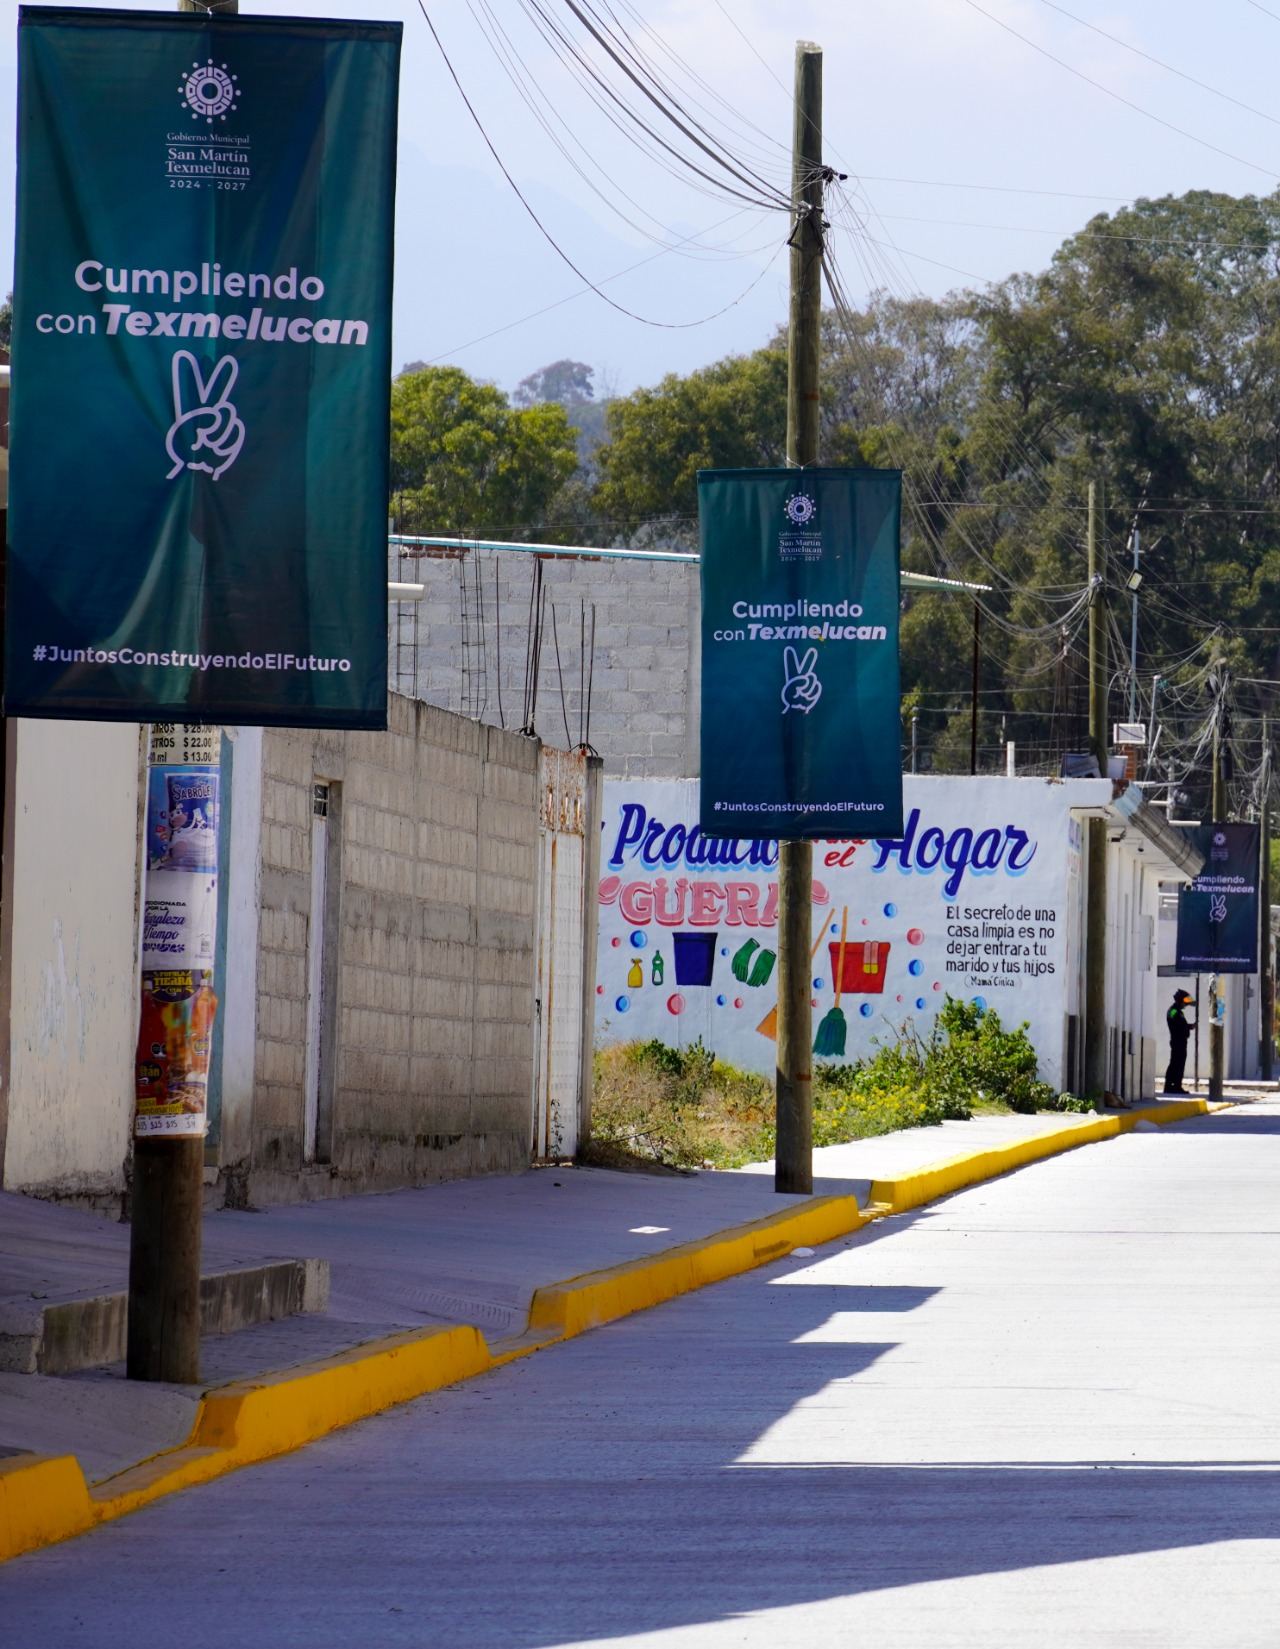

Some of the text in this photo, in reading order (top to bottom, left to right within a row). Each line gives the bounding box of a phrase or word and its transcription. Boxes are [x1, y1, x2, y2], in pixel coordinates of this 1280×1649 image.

[166, 132, 250, 145] Gobierno Municipal
[168, 148, 248, 162] San Martín
[165, 161, 250, 175] Texmelucan
[169, 180, 201, 189] 2024
[217, 181, 246, 190] 2027
[74, 260, 325, 303] Cumpliendo
[35, 303, 369, 346] con Texmelucan
[778, 546, 822, 554] Texmelucan
[779, 539, 794, 547] San
[732, 600, 863, 622] Cumpliendo
[713, 622, 887, 641] con Texmelucan
[33, 644, 351, 672] #JuntosConstruyendoElFuturo
[713, 801, 884, 814] #JuntosConstruyendoElFuturo
[824, 846, 857, 868] el
[871, 808, 1038, 897] Hogar
[1196, 884, 1255, 893] Texmelucan
[946, 903, 1056, 921] El secreto de una
[947, 922, 1055, 941] casa limpia es no
[946, 940, 982, 957] dejar
[1033, 942, 1046, 956] tu
[946, 957, 1055, 977] marido y tus hijos
